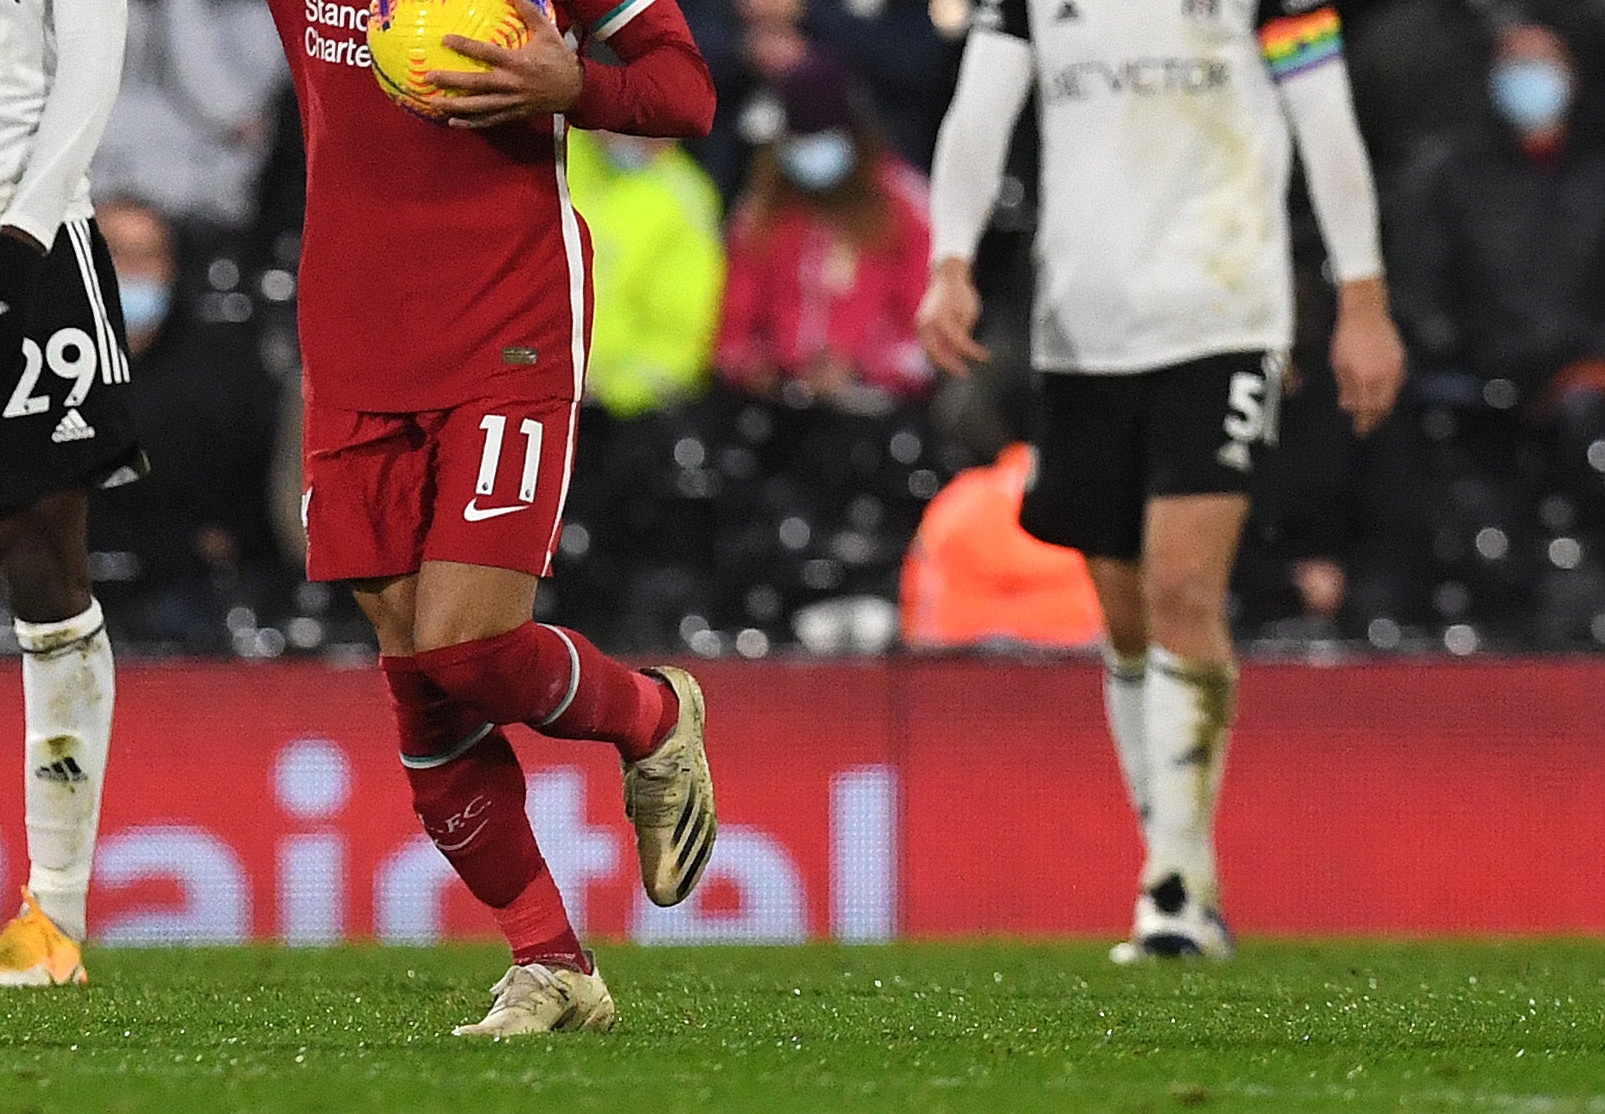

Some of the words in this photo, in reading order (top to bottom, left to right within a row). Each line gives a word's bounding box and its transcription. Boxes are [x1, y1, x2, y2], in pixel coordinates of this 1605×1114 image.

[2, 327, 97, 419] 29
[1223, 371, 1264, 442] 5
[475, 414, 544, 504] 11
